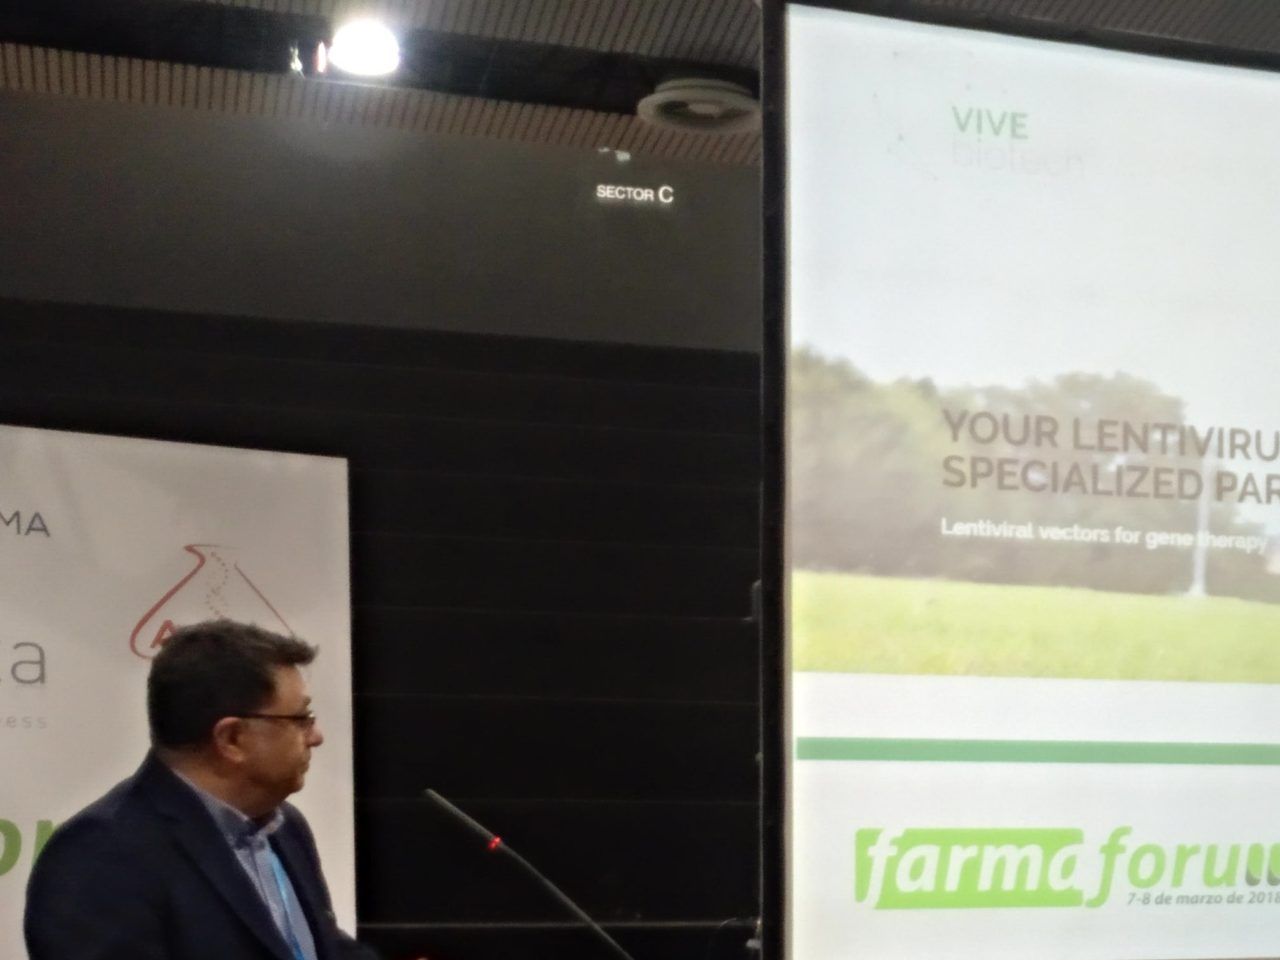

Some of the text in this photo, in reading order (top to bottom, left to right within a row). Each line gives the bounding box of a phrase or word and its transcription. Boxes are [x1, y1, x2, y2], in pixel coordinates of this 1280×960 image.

[952, 105, 1028, 139] VIVE
[596, 184, 674, 203] SECTOR C
[942, 409, 1058, 447] YOUR
[942, 455, 1204, 501] SPECIALIZED
[941, 517, 1269, 554] Lentiviral vectors for gene therapy
[1128, 892, 1151, 906] 7-8
[1155, 892, 1172, 904] de
[1176, 894, 1222, 904] marzo
[1226, 892, 1244, 904] de
